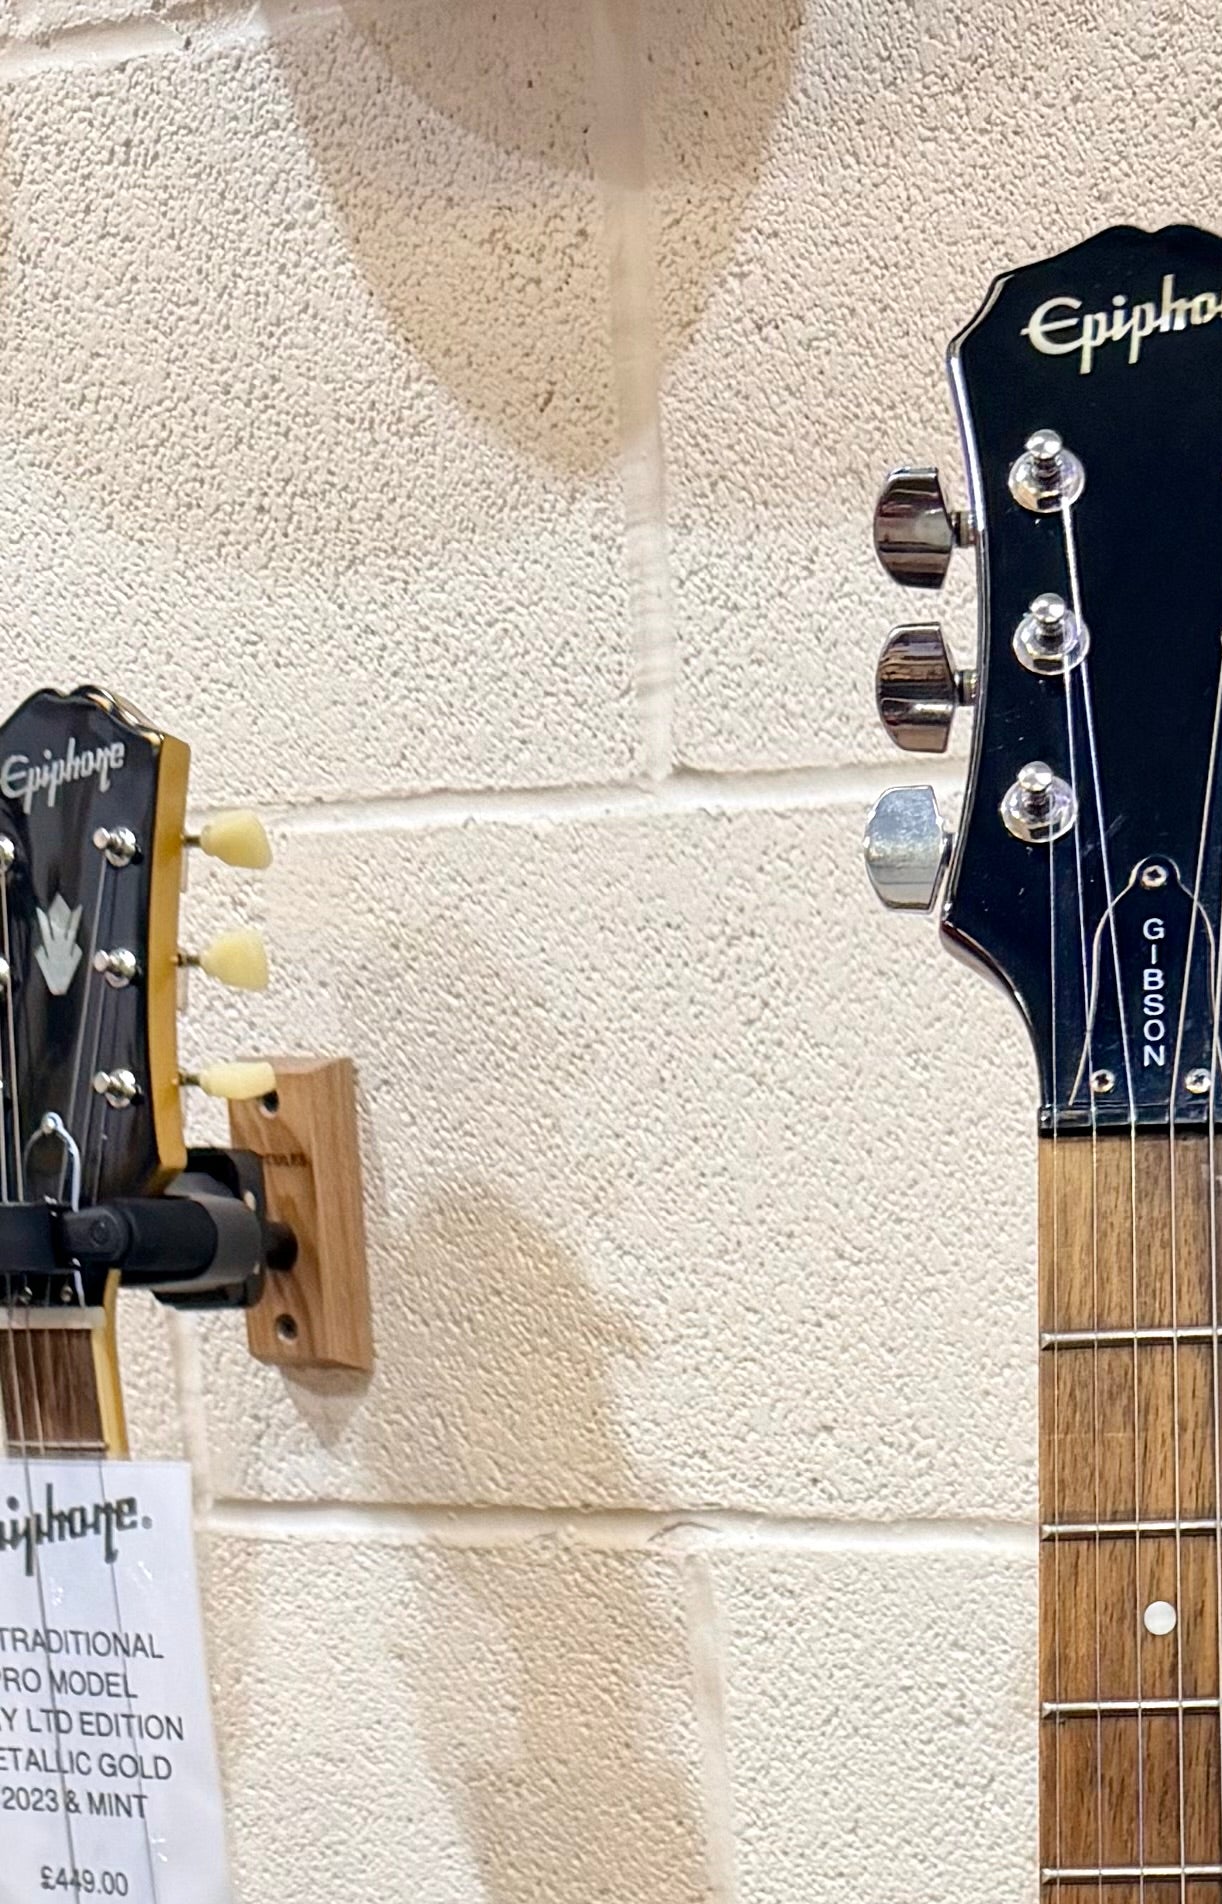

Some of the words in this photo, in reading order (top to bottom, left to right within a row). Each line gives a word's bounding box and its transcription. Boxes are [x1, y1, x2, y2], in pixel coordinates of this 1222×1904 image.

[1, 737, 126, 814] Epiphone
[1140, 917, 1167, 1068] GIBSON
[0, 1626, 164, 1660] TRADITIONAL
[0, 1666, 42, 1693] RO
[50, 1669, 138, 1699] MODEL
[26, 1707, 73, 1735] LTD
[79, 1711, 184, 1741] EDITION
[0, 1746, 92, 1776] ETALLIC
[98, 1753, 172, 1781] GOLD
[1, 1786, 59, 1813] 2023
[65, 1789, 82, 1814] &
[87, 1791, 149, 1819] MINT
[40, 1865, 129, 1897] £449.00
